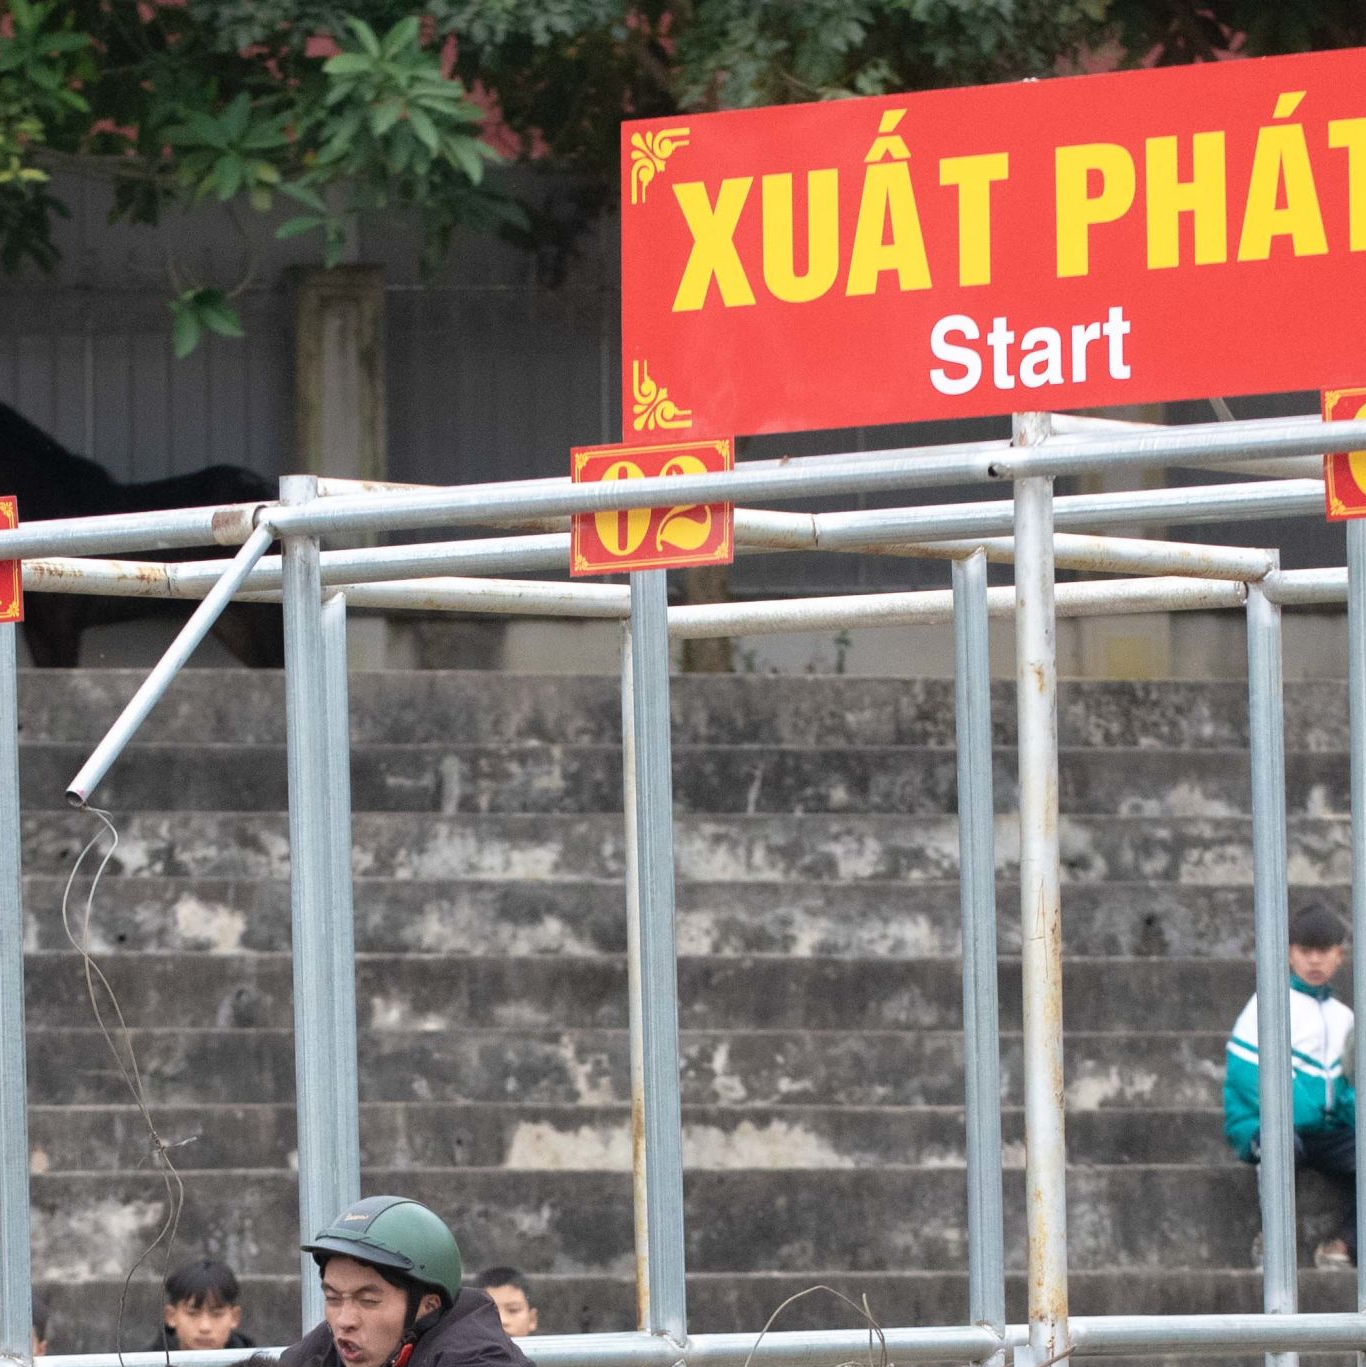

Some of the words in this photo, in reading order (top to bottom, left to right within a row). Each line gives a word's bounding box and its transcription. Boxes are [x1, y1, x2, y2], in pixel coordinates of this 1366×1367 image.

[671, 108, 1010, 312] XUẤT
[929, 306, 1132, 396] Start
[594, 455, 712, 557] 02
